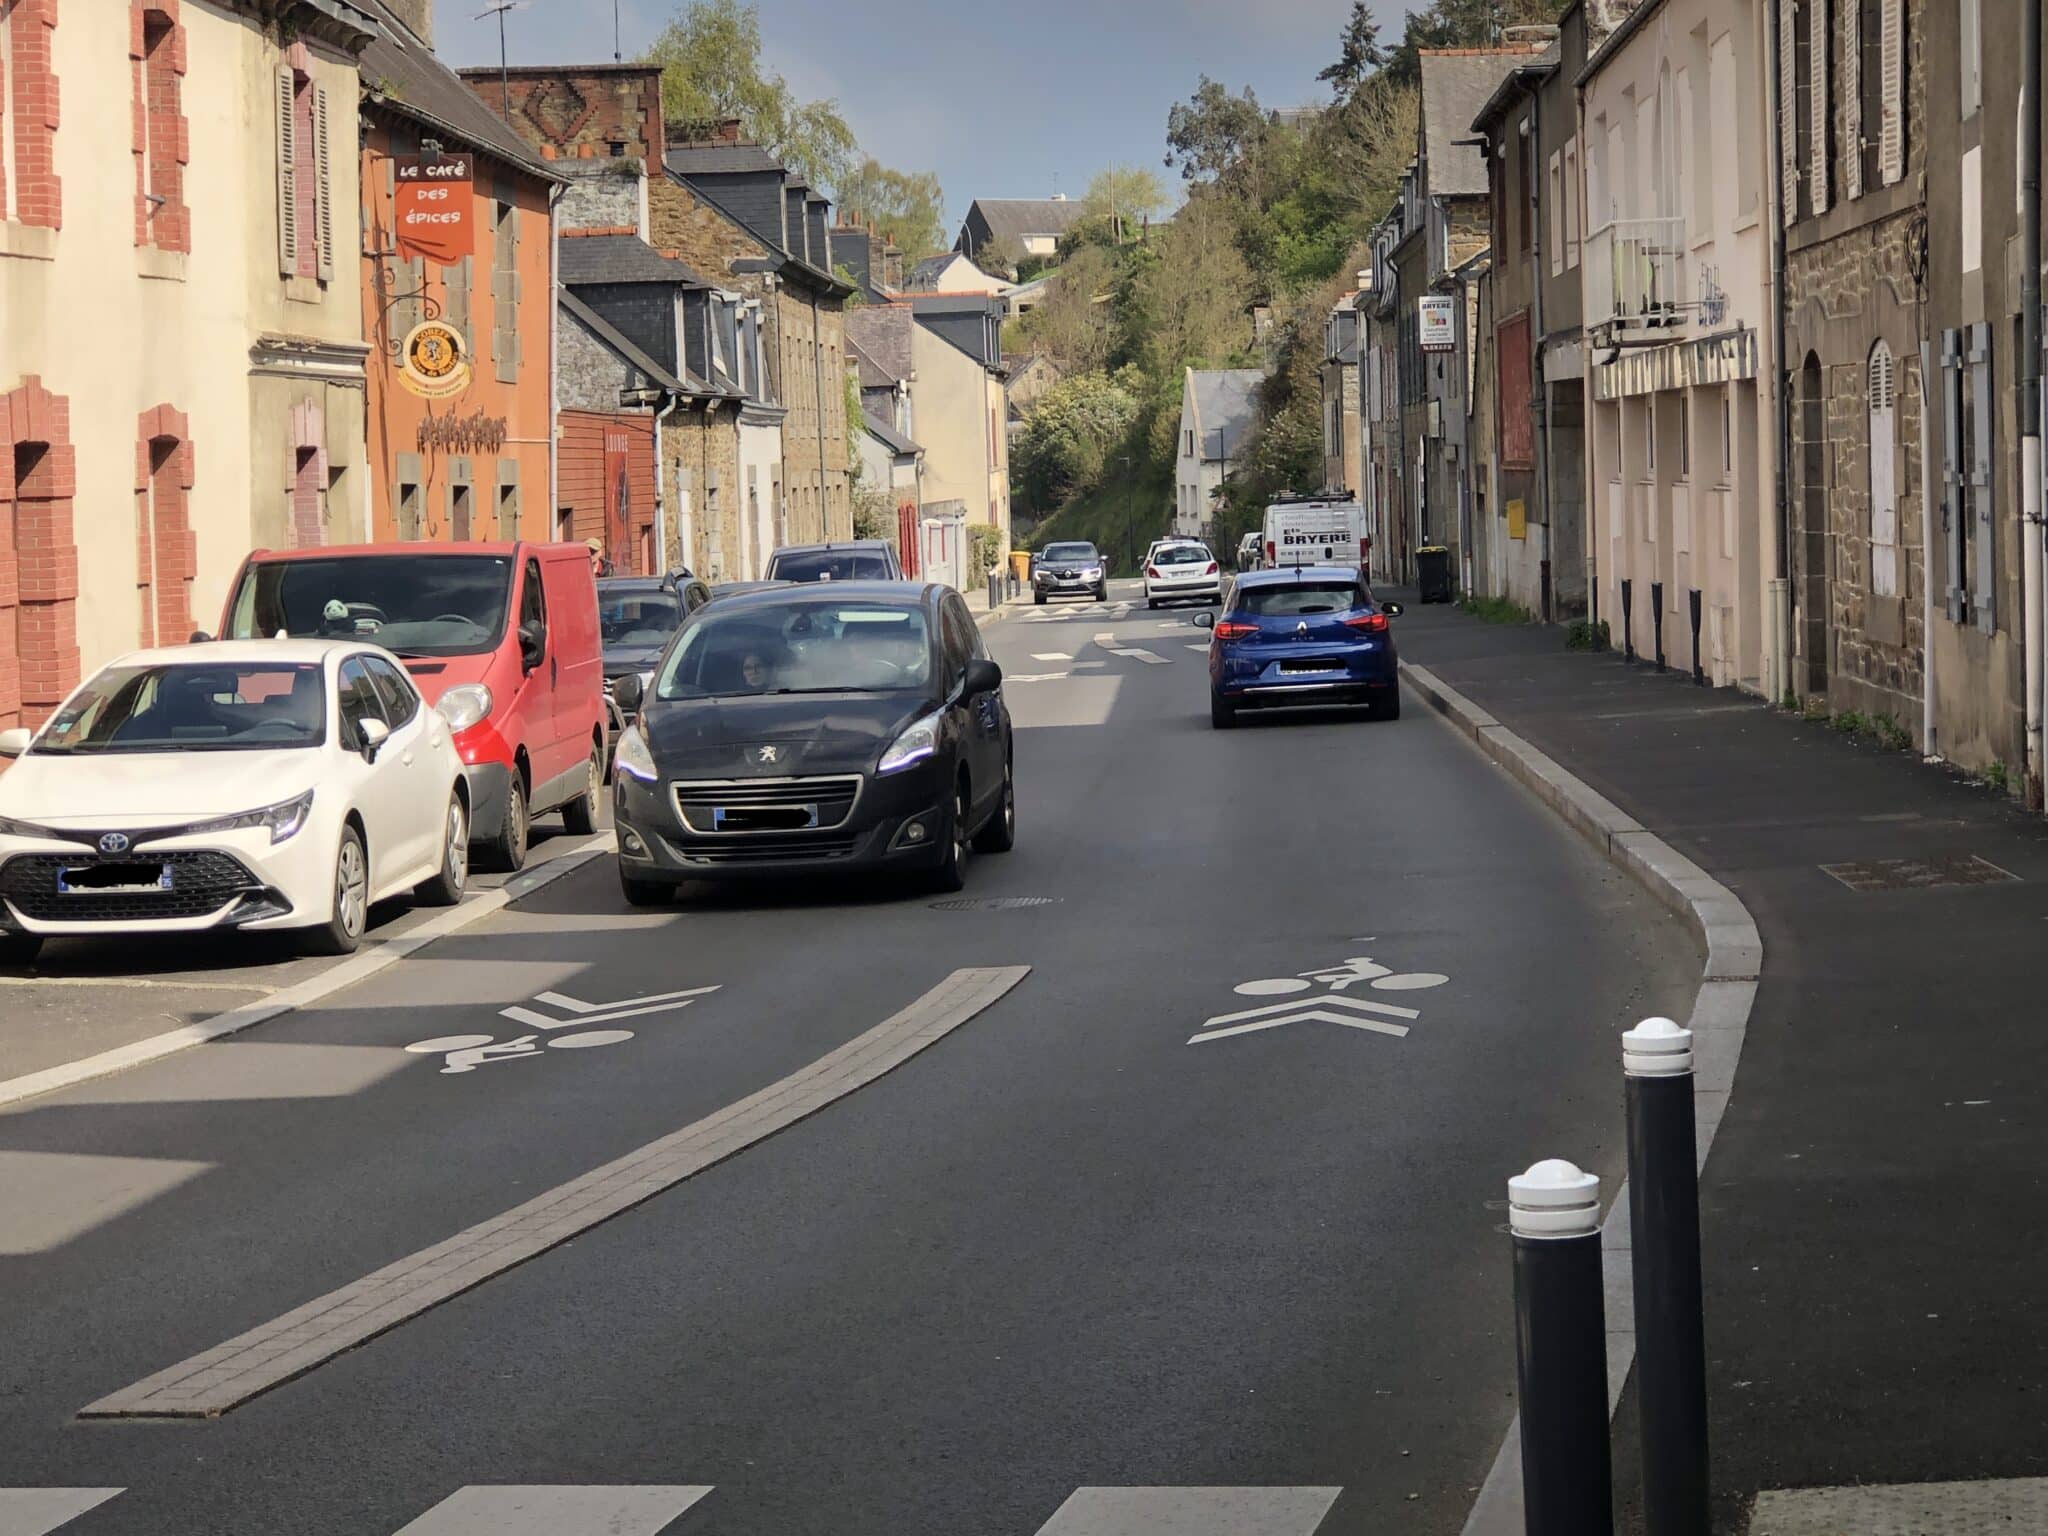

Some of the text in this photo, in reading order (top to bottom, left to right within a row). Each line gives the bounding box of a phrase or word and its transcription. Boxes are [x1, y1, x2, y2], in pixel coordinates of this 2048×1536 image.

[399, 160, 465, 177] LE CAFÉ
[417, 188, 448, 201] DES
[405, 208, 461, 224] ÉPICES
